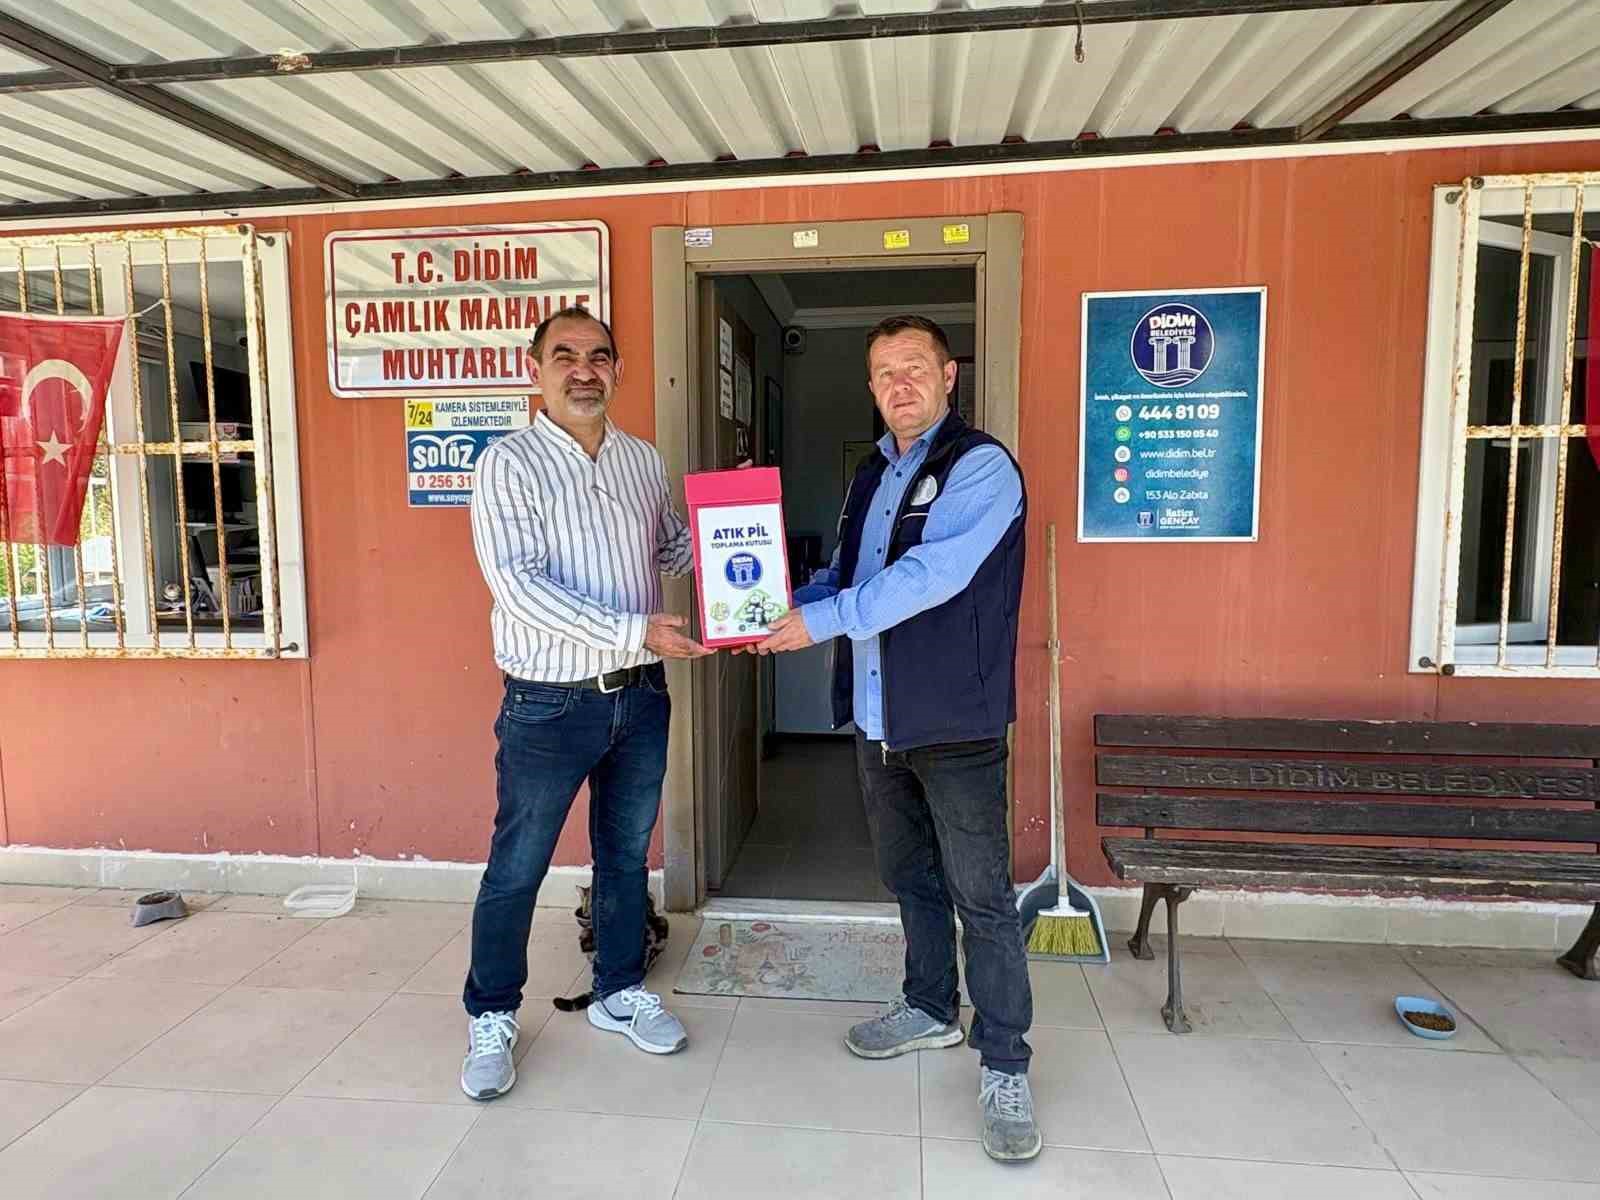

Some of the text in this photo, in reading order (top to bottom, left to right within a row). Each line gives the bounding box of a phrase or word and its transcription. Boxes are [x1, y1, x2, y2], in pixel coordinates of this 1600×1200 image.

[391, 241, 538, 284] T.C. DİDİM
[345, 299, 450, 338] ÇAMLIK
[1149, 312, 1196, 329] DİDİM
[1150, 327, 1196, 337] BELEDİYESİ
[383, 346, 522, 380] MUHTARLI
[435, 400, 528, 413] KAMERA SİSTEMLERİYLE
[1138, 404, 1220, 420] 444 81 09
[408, 403, 432, 427] 7/24
[451, 415, 512, 427] İZLENMEKTEDİR
[1140, 448, 1216, 458] www.didim.bel.tr
[417, 474, 472, 488] 0 256 31
[1145, 469, 1209, 479] didimbelediye
[1145, 490, 1161, 500] 153
[1162, 490, 1178, 500] Alo
[1160, 516, 1200, 527] GENÇAY
[713, 522, 769, 540] ATIK PİL
[711, 539, 772, 549] TOPLAMA KUTUSU
[1176, 763, 1239, 785] T.C.
[1250, 763, 1360, 788] DİDİM
